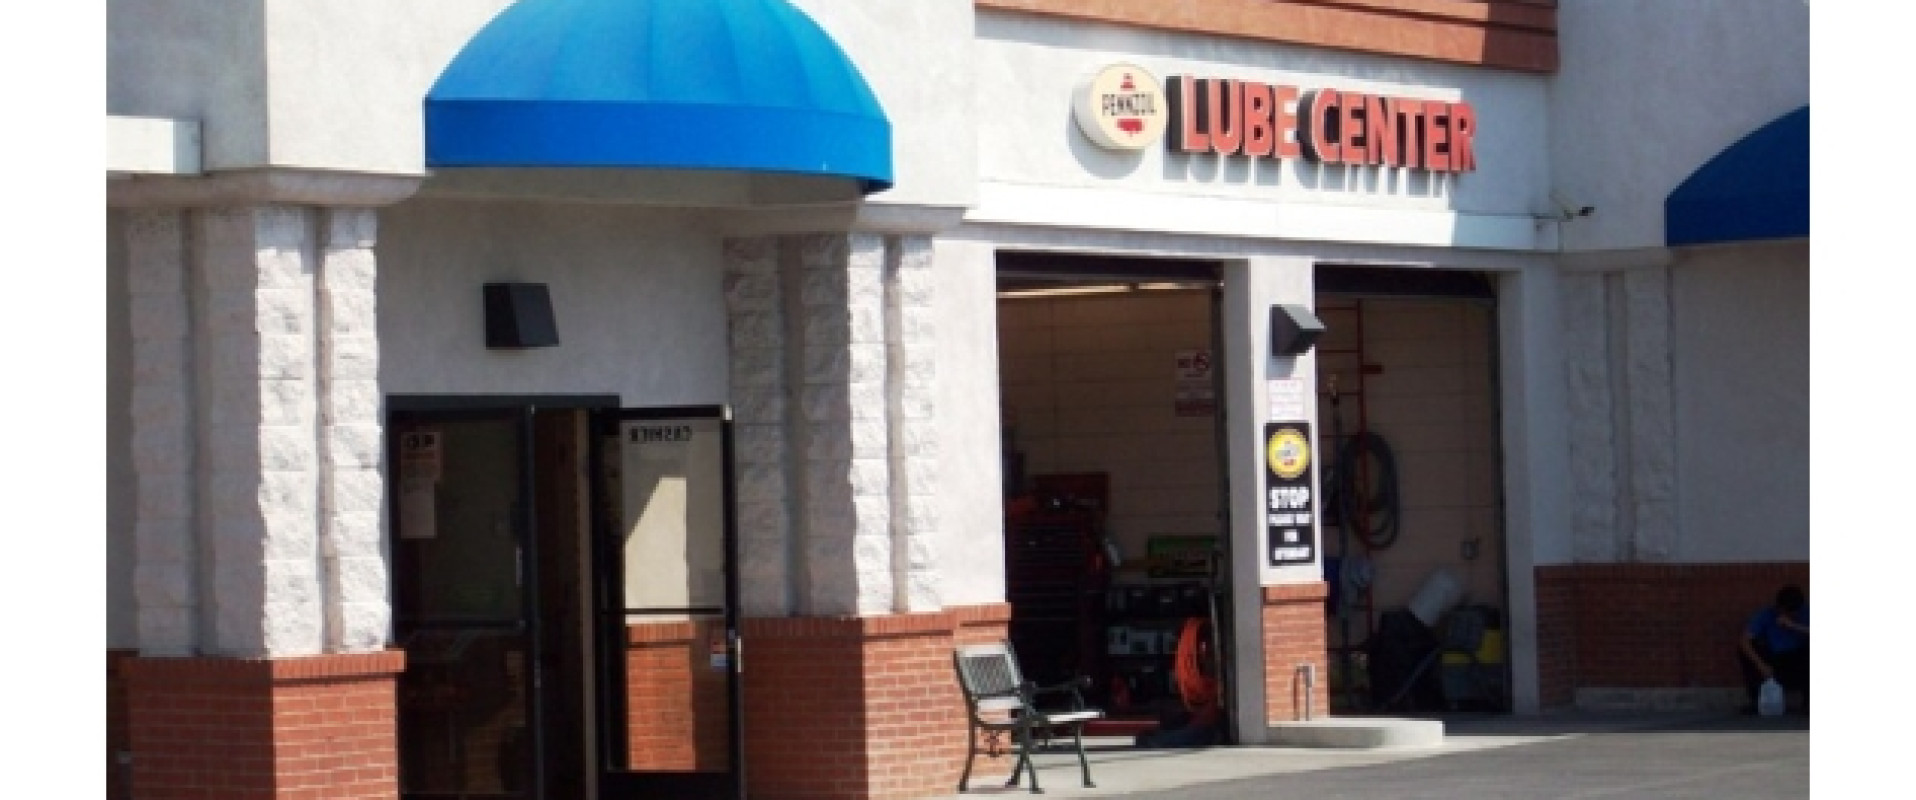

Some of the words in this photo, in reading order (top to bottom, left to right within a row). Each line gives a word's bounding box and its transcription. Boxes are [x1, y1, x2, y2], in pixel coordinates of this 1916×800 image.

[1102, 93, 1157, 116] PENNZOIL
[1182, 73, 1300, 159] LUBE
[1312, 88, 1476, 173] CENTER
[1268, 486, 1310, 511] STOP
